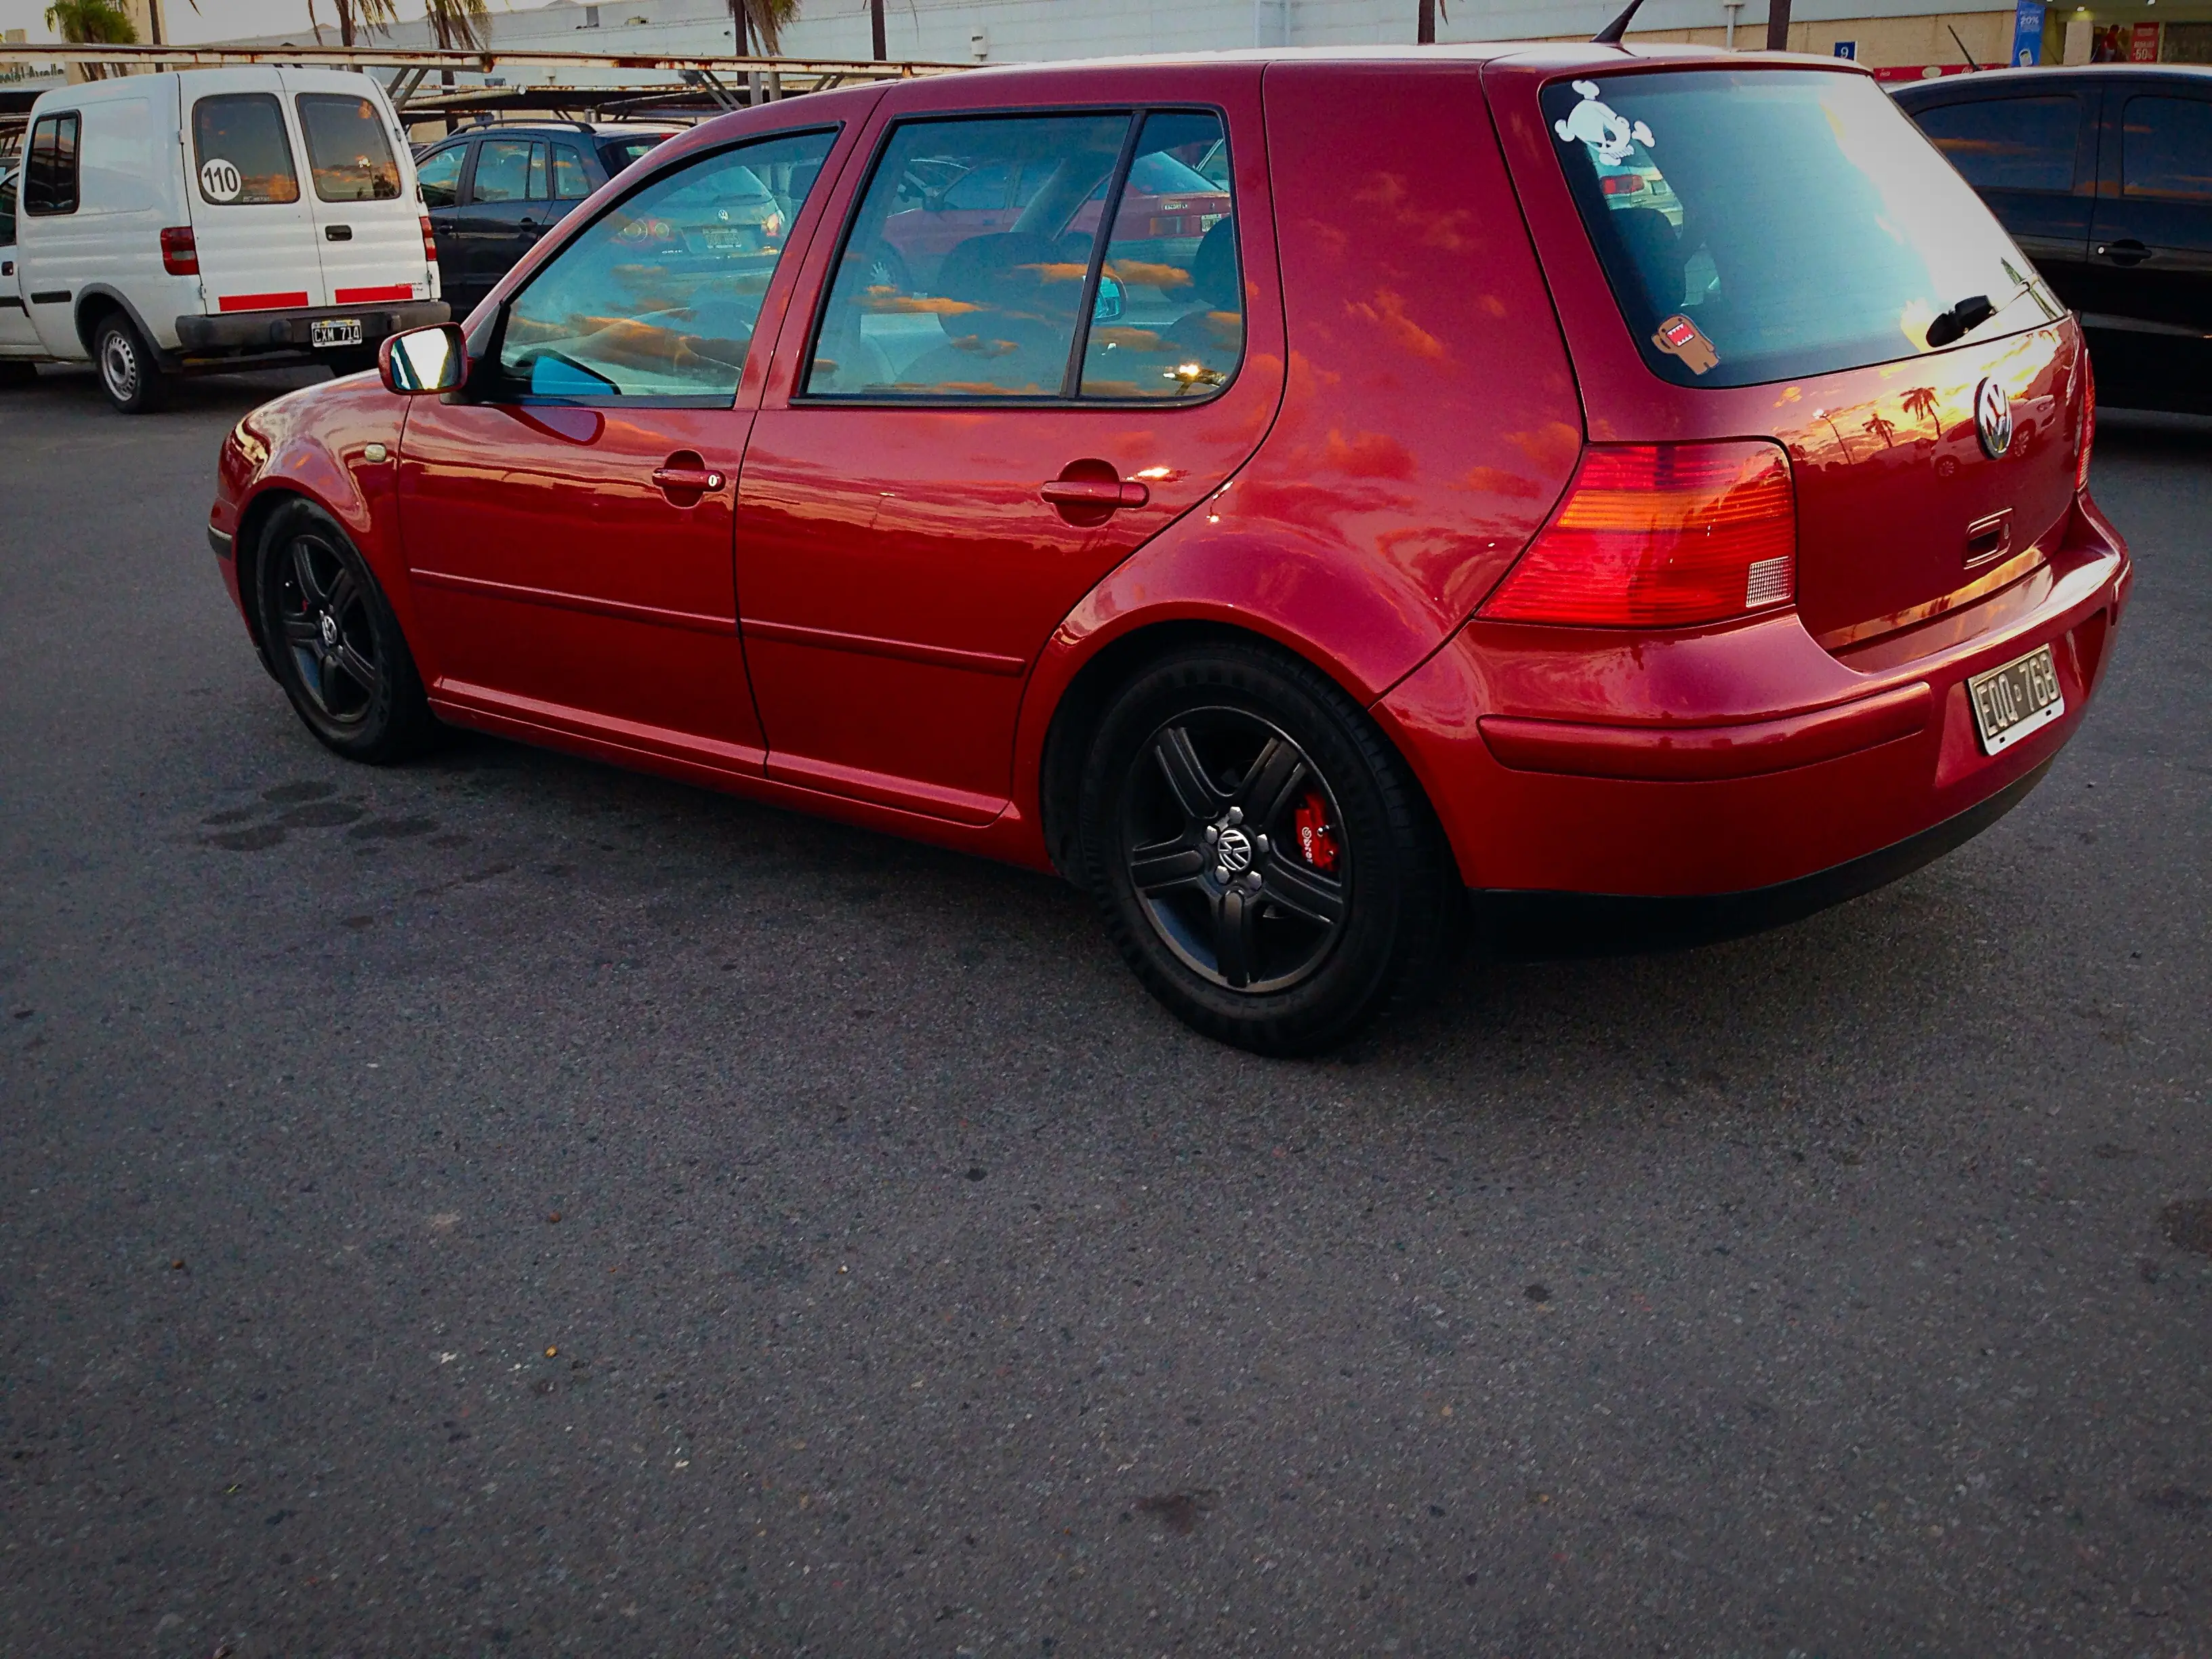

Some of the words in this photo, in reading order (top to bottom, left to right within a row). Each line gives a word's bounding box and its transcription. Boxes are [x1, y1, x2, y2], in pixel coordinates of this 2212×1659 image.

[204, 167, 238, 192] 110
[314, 327, 334, 342] CXM
[340, 326, 360, 341] 714
[1977, 672, 2020, 737] EQQ
[2018, 652, 2060, 712] 768
